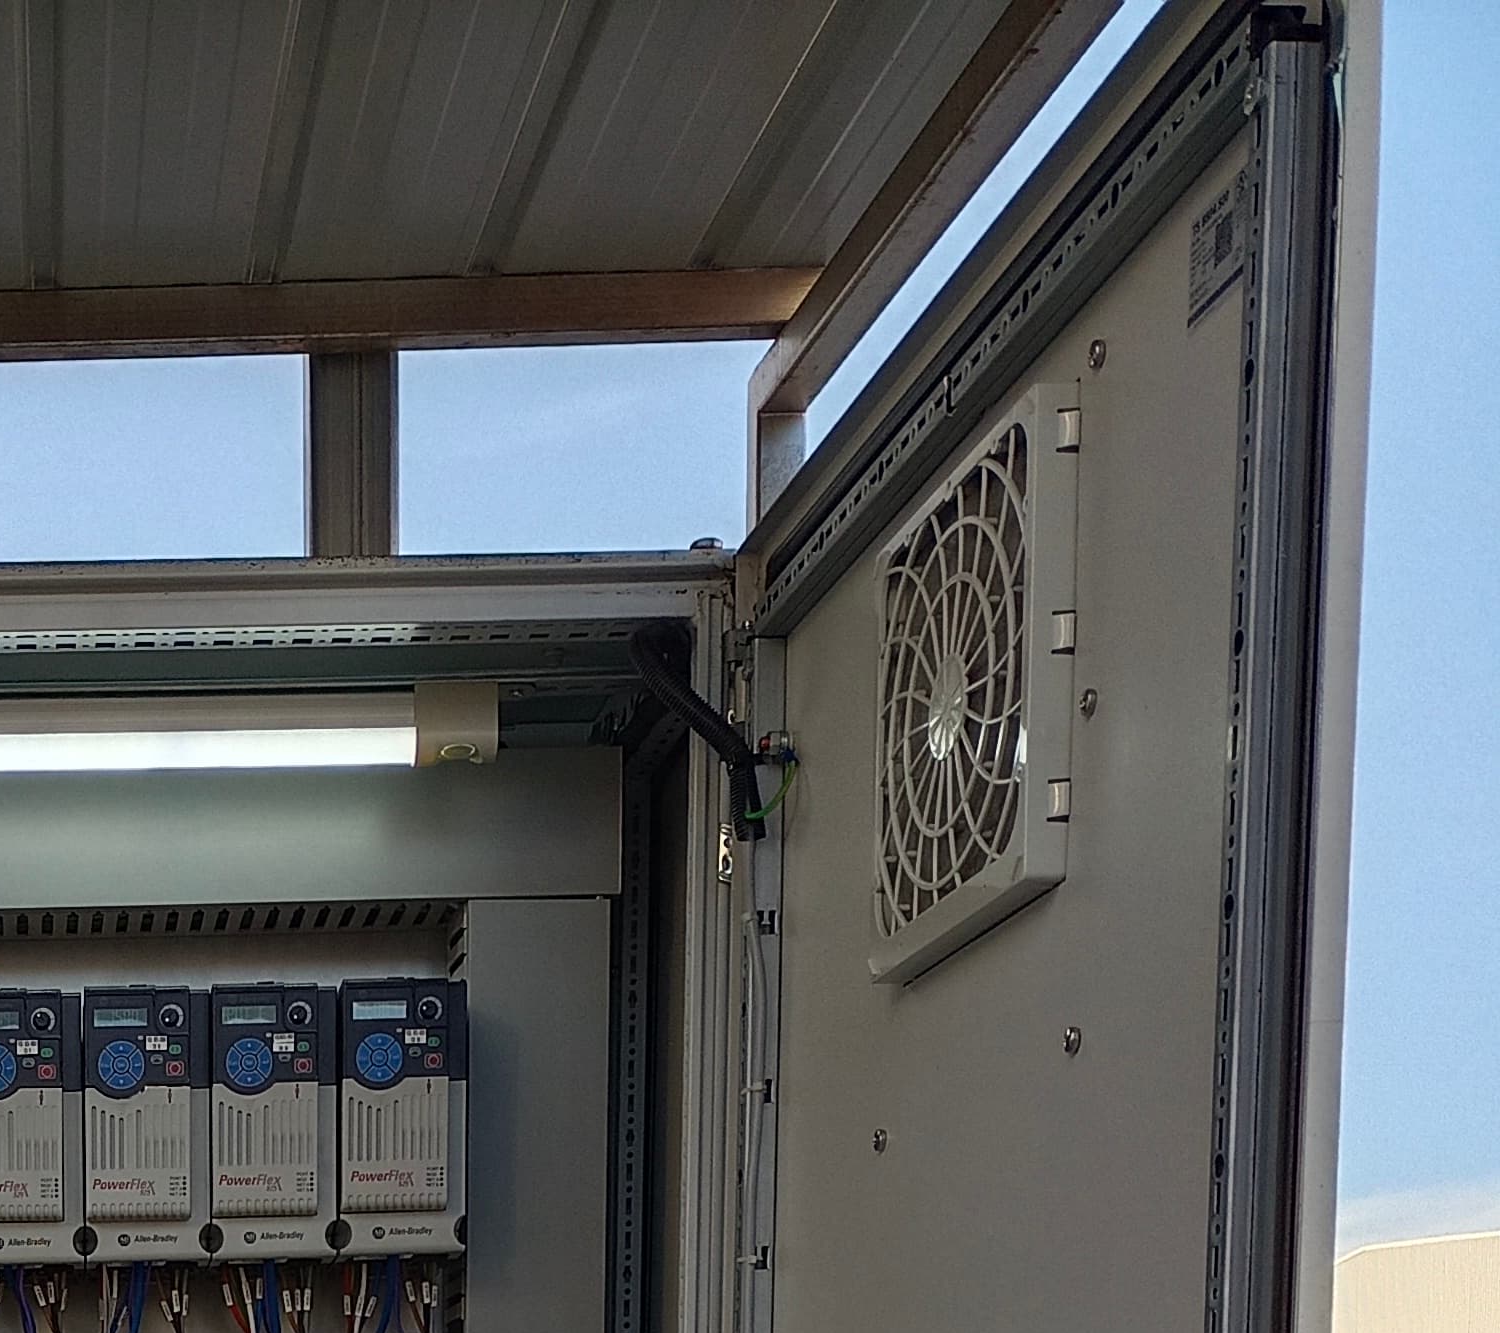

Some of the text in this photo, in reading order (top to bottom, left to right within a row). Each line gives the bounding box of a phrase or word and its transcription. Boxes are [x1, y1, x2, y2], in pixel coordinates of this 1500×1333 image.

[218, 1174, 283, 1192] PowerFlex
[351, 1170, 414, 1187] PowerFlex
[93, 1178, 156, 1196] PowerFlex
[260, 1231, 304, 1240] Allen-Bradley
[389, 1226, 433, 1236] Allen-Bradley
[8, 1238, 51, 1248] Allen-Bradley
[134, 1234, 178, 1243] Allen-Bradley
